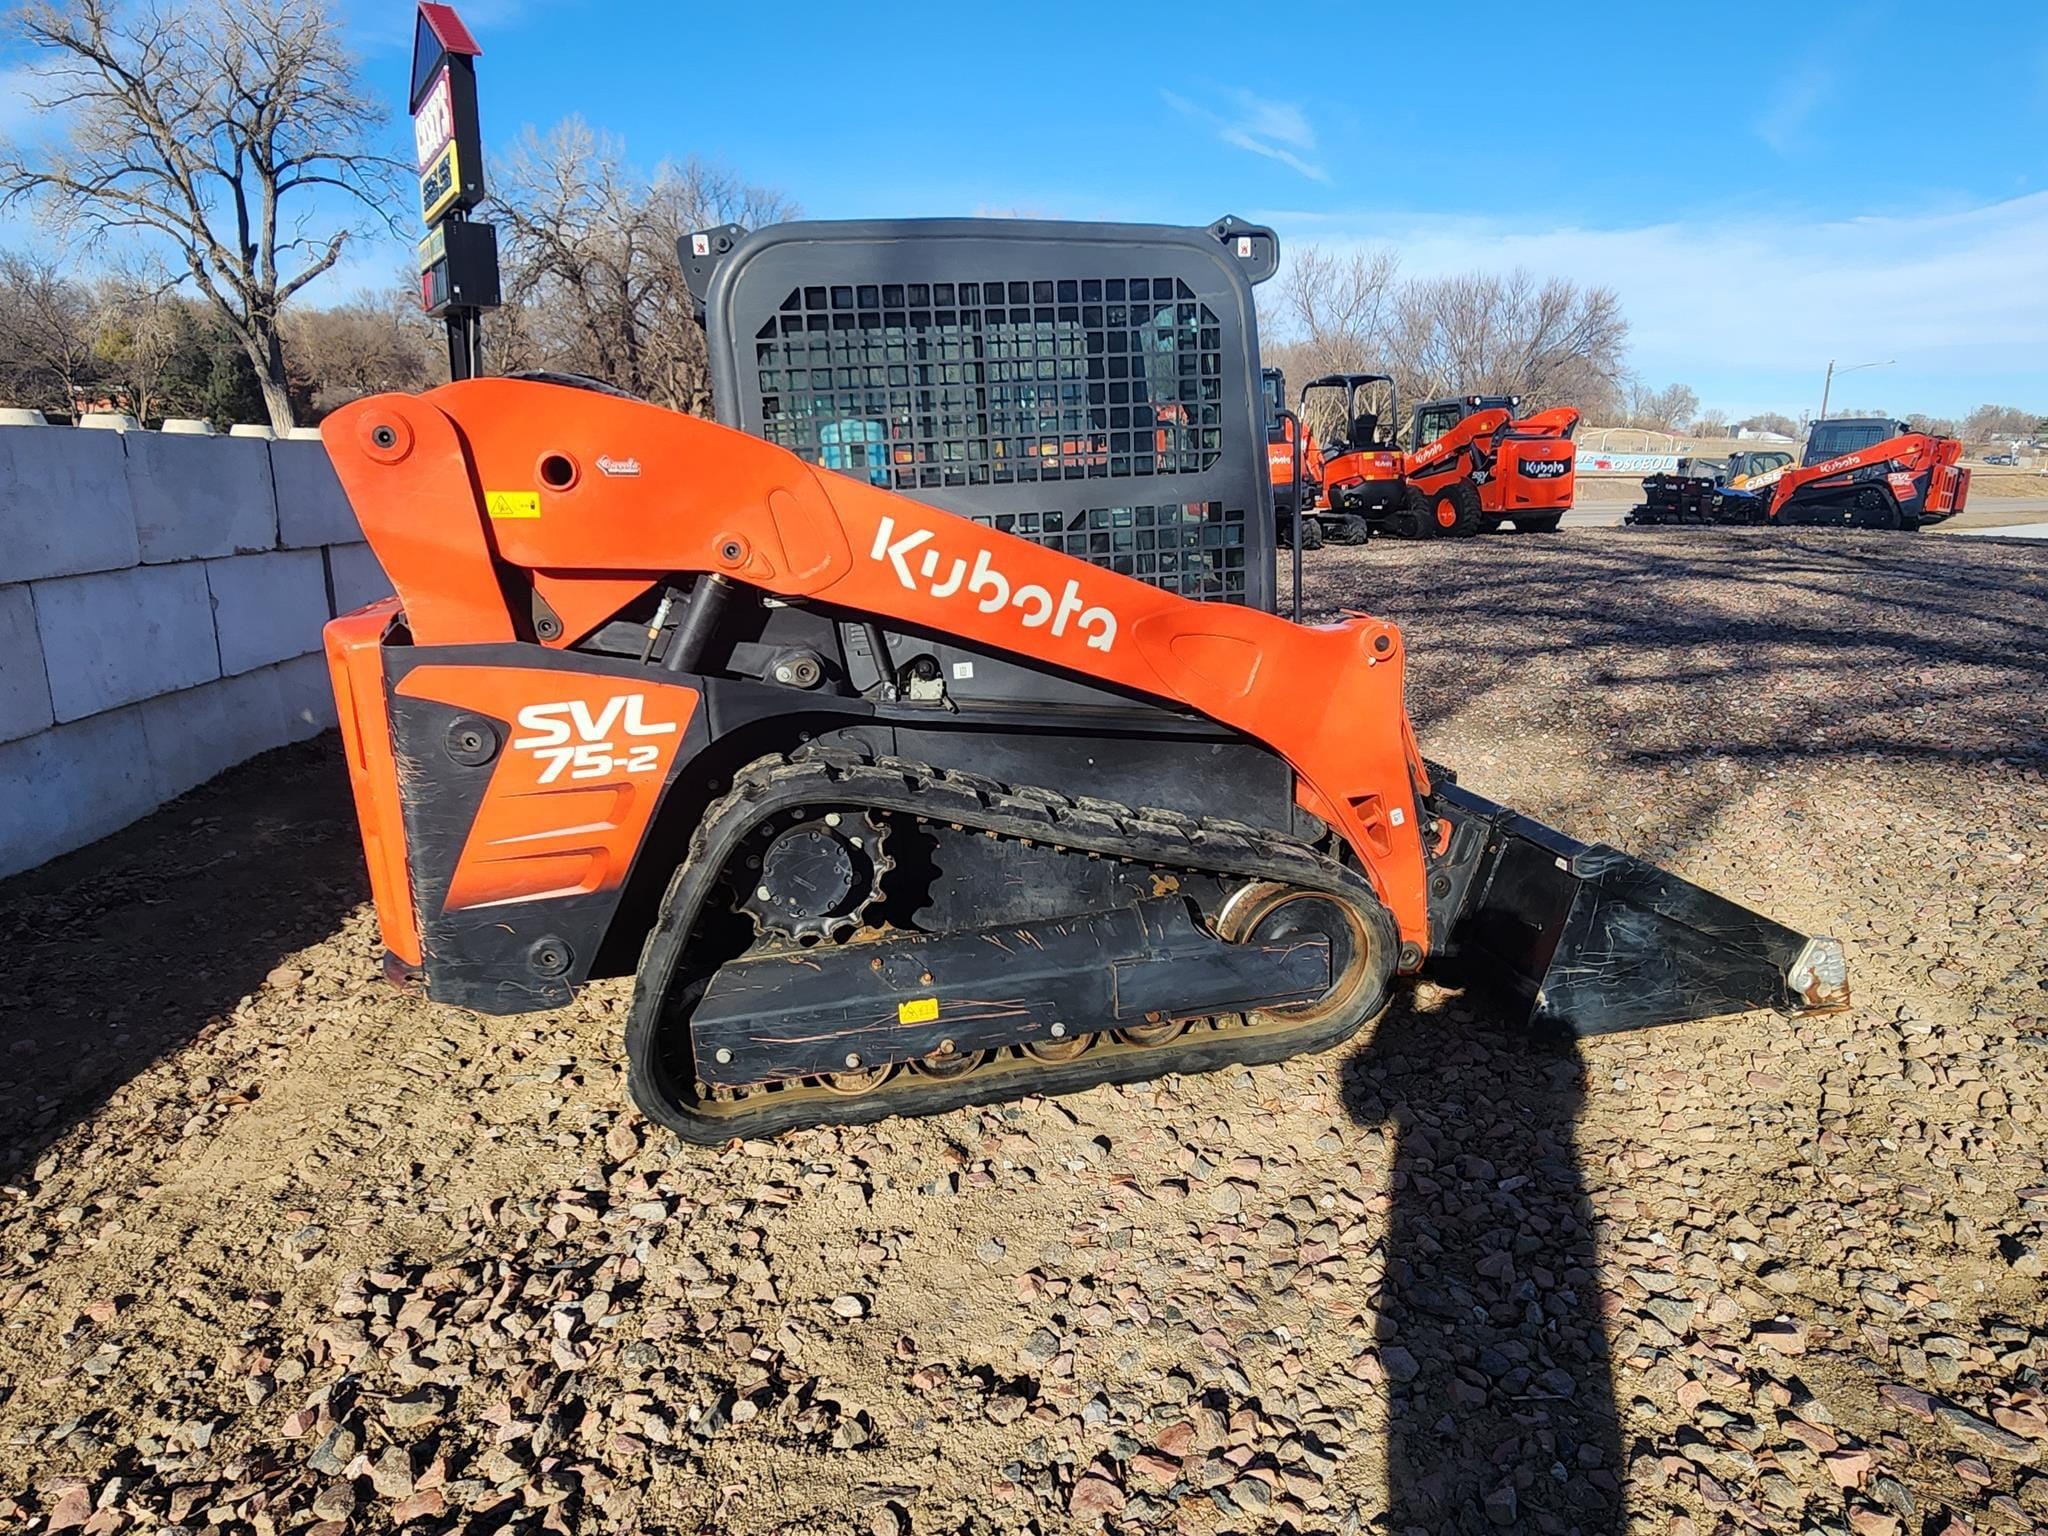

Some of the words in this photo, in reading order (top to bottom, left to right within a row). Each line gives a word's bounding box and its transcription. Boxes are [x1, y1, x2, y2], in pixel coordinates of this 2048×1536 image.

[1415, 442, 1443, 464] Kubota
[1819, 454, 1861, 473] Kubota
[1525, 460, 1565, 474] Kubota
[1744, 470, 1782, 492] CASE
[870, 515, 1118, 653] Kubota
[513, 693, 677, 750] SVL
[532, 741, 660, 785] 75-2
